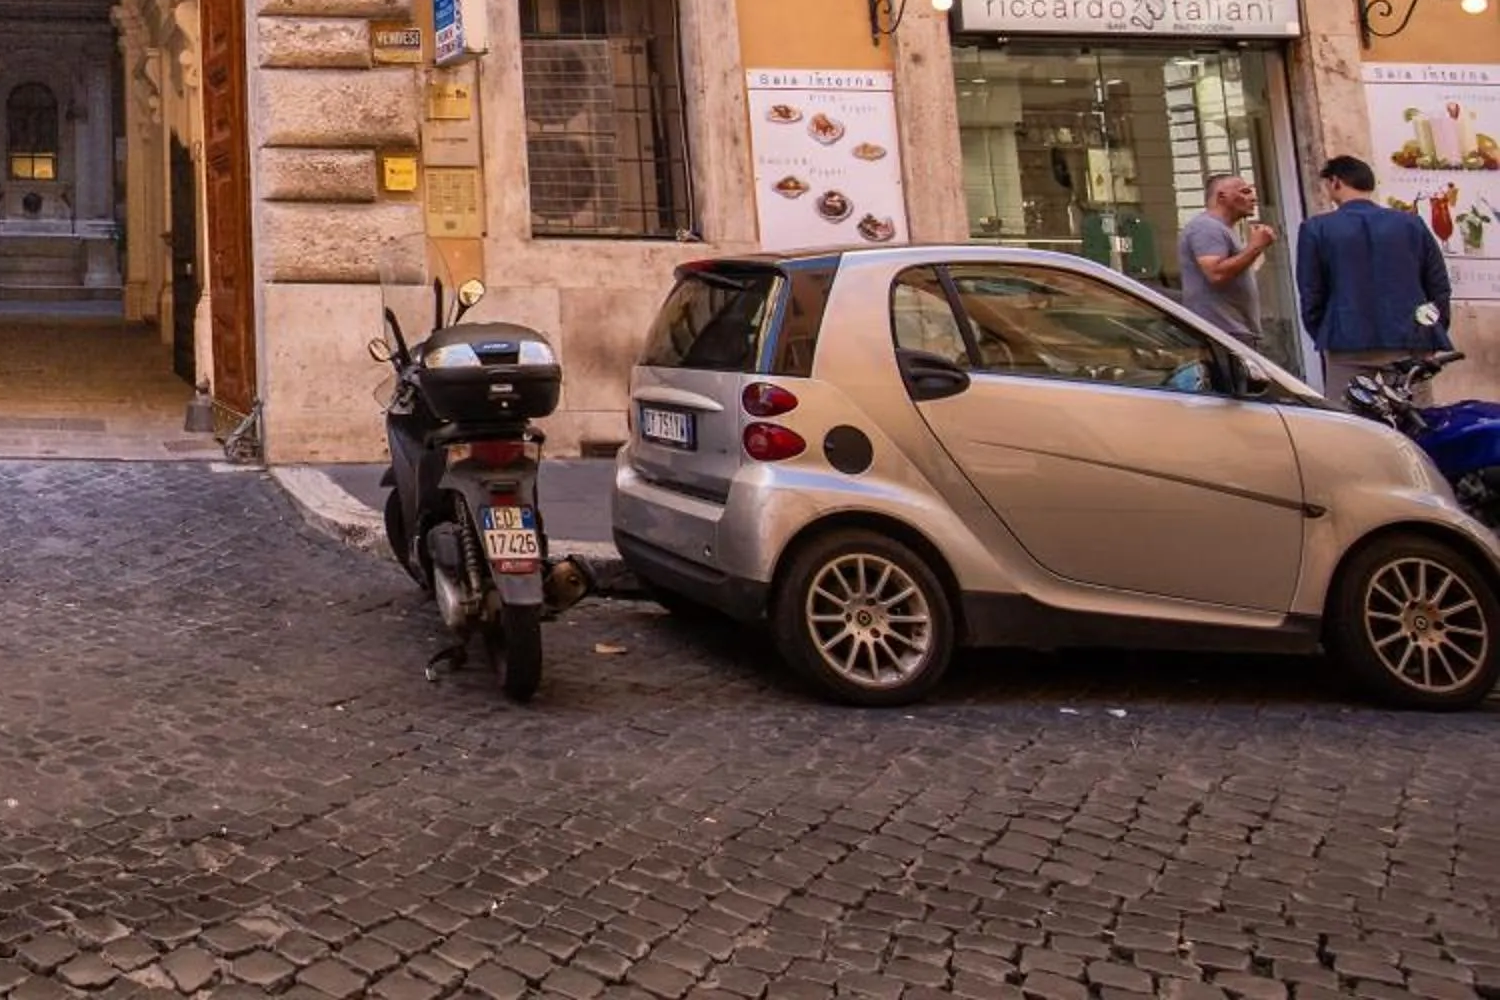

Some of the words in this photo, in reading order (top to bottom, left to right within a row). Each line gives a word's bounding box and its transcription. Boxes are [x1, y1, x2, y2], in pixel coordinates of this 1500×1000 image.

[375, 30, 420, 46] VENDESI
[759, 73, 798, 85] Sala
[489, 533, 537, 555] 17426
